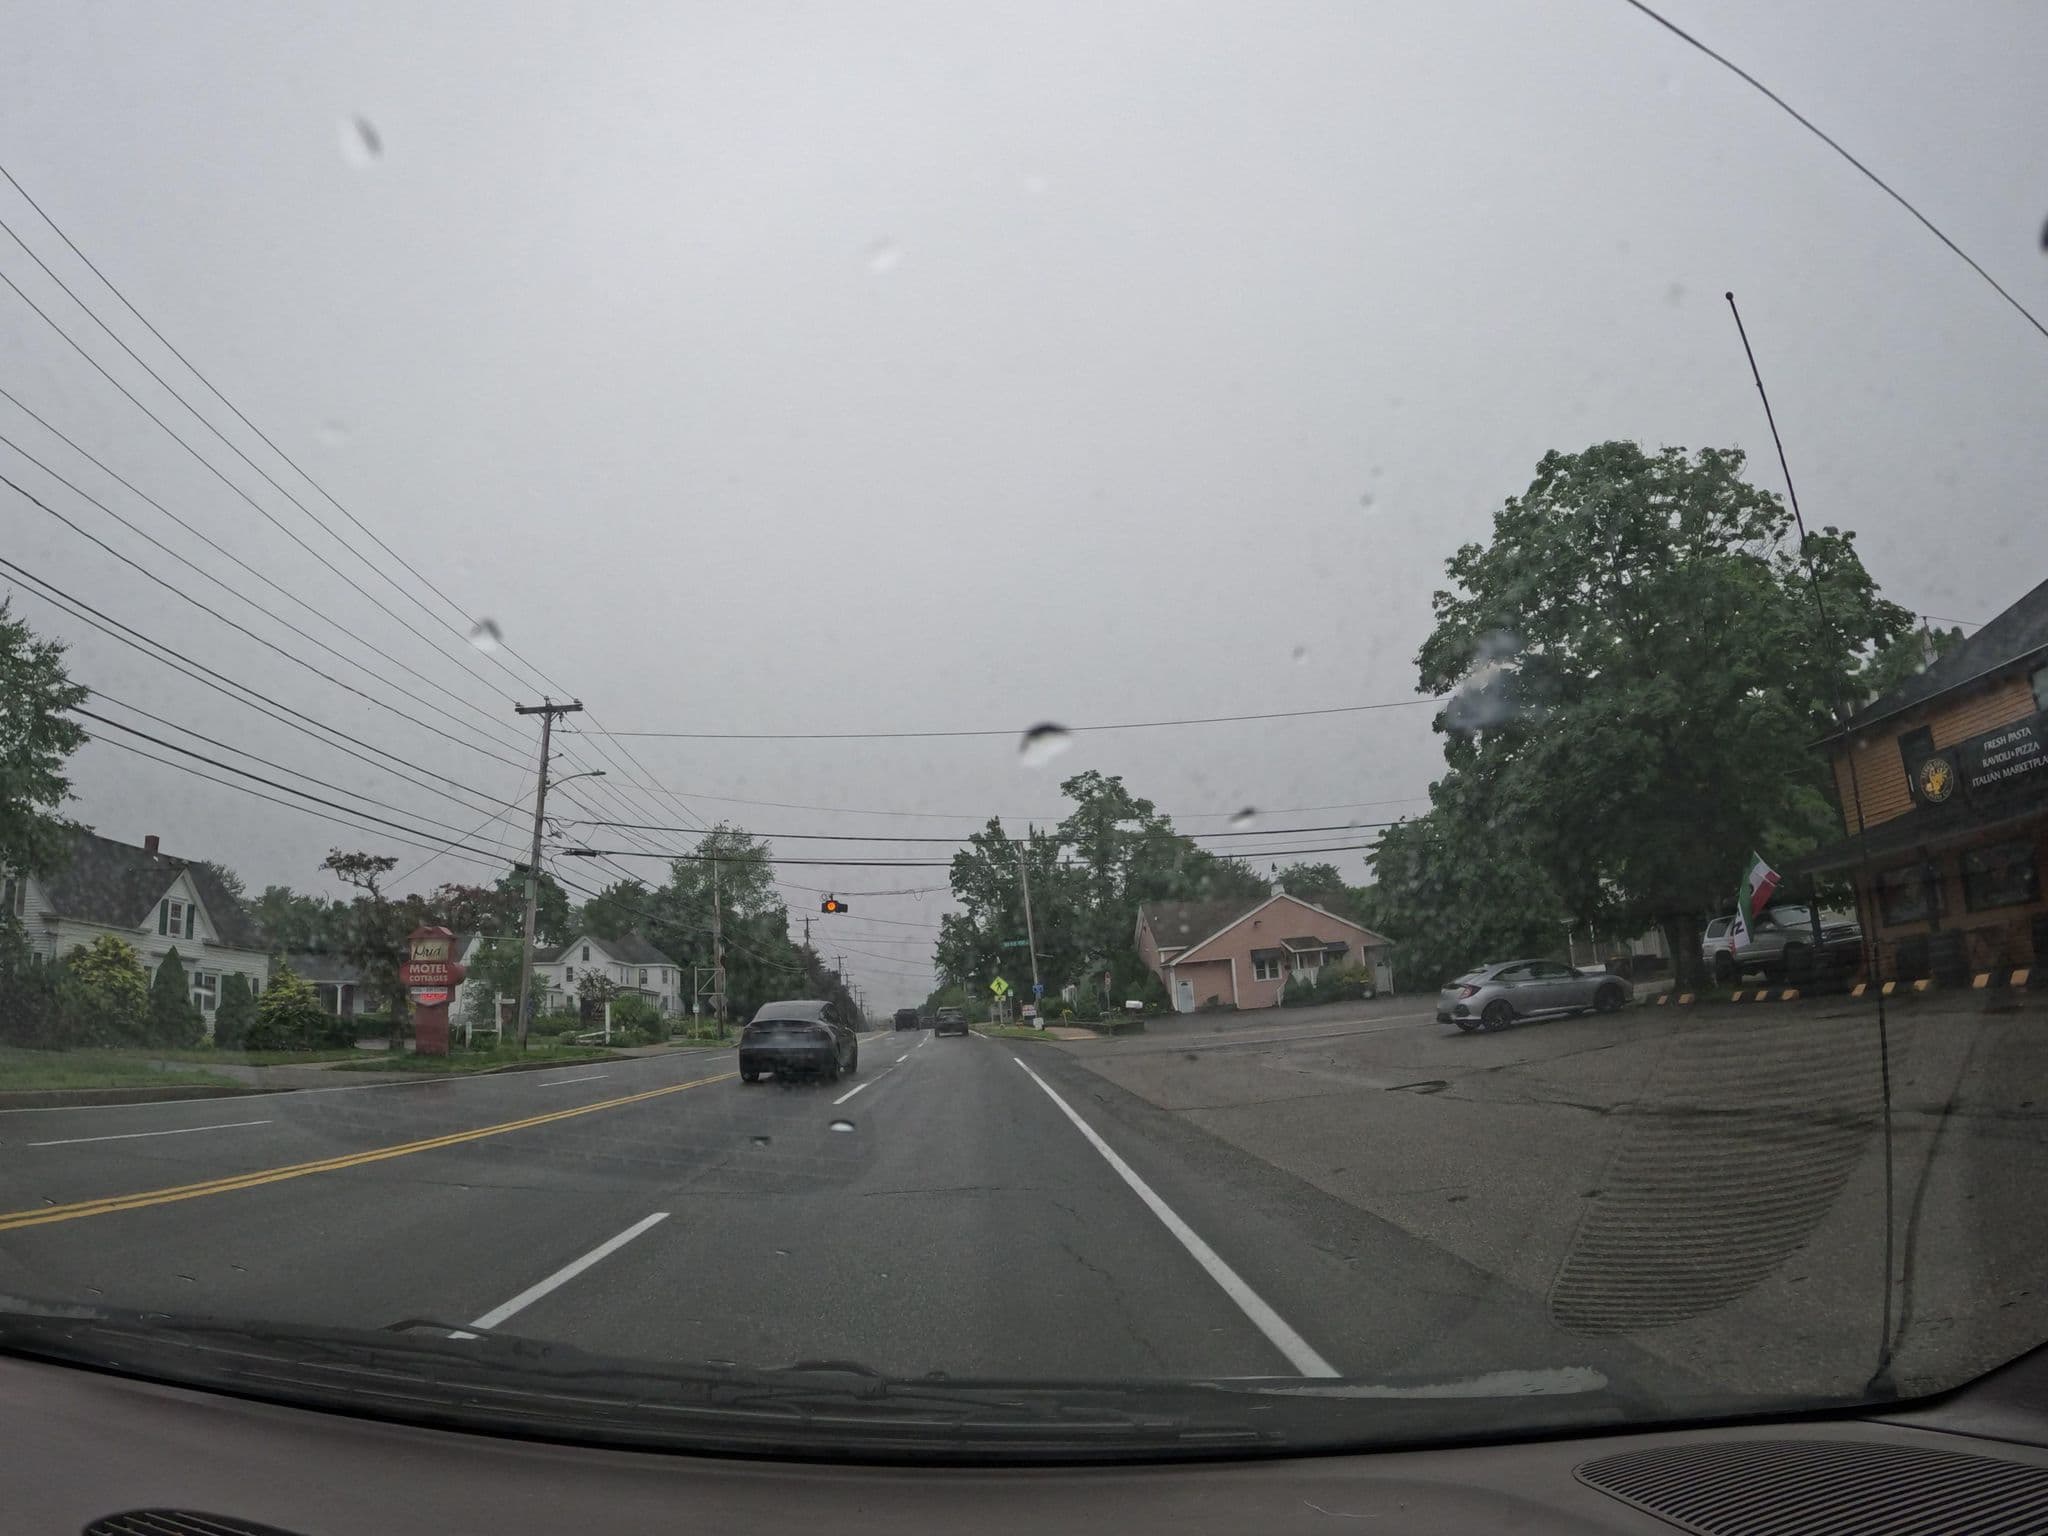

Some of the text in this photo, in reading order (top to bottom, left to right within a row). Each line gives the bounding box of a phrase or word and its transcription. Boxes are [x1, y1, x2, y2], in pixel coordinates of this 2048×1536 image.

[1984, 727, 2032, 751] FRESH PASTA
[1982, 741, 2040, 768] RAVIOLI PIZZA
[1972, 770, 2001, 787] ITALIAN
[409, 964, 448, 974] MOTEL
